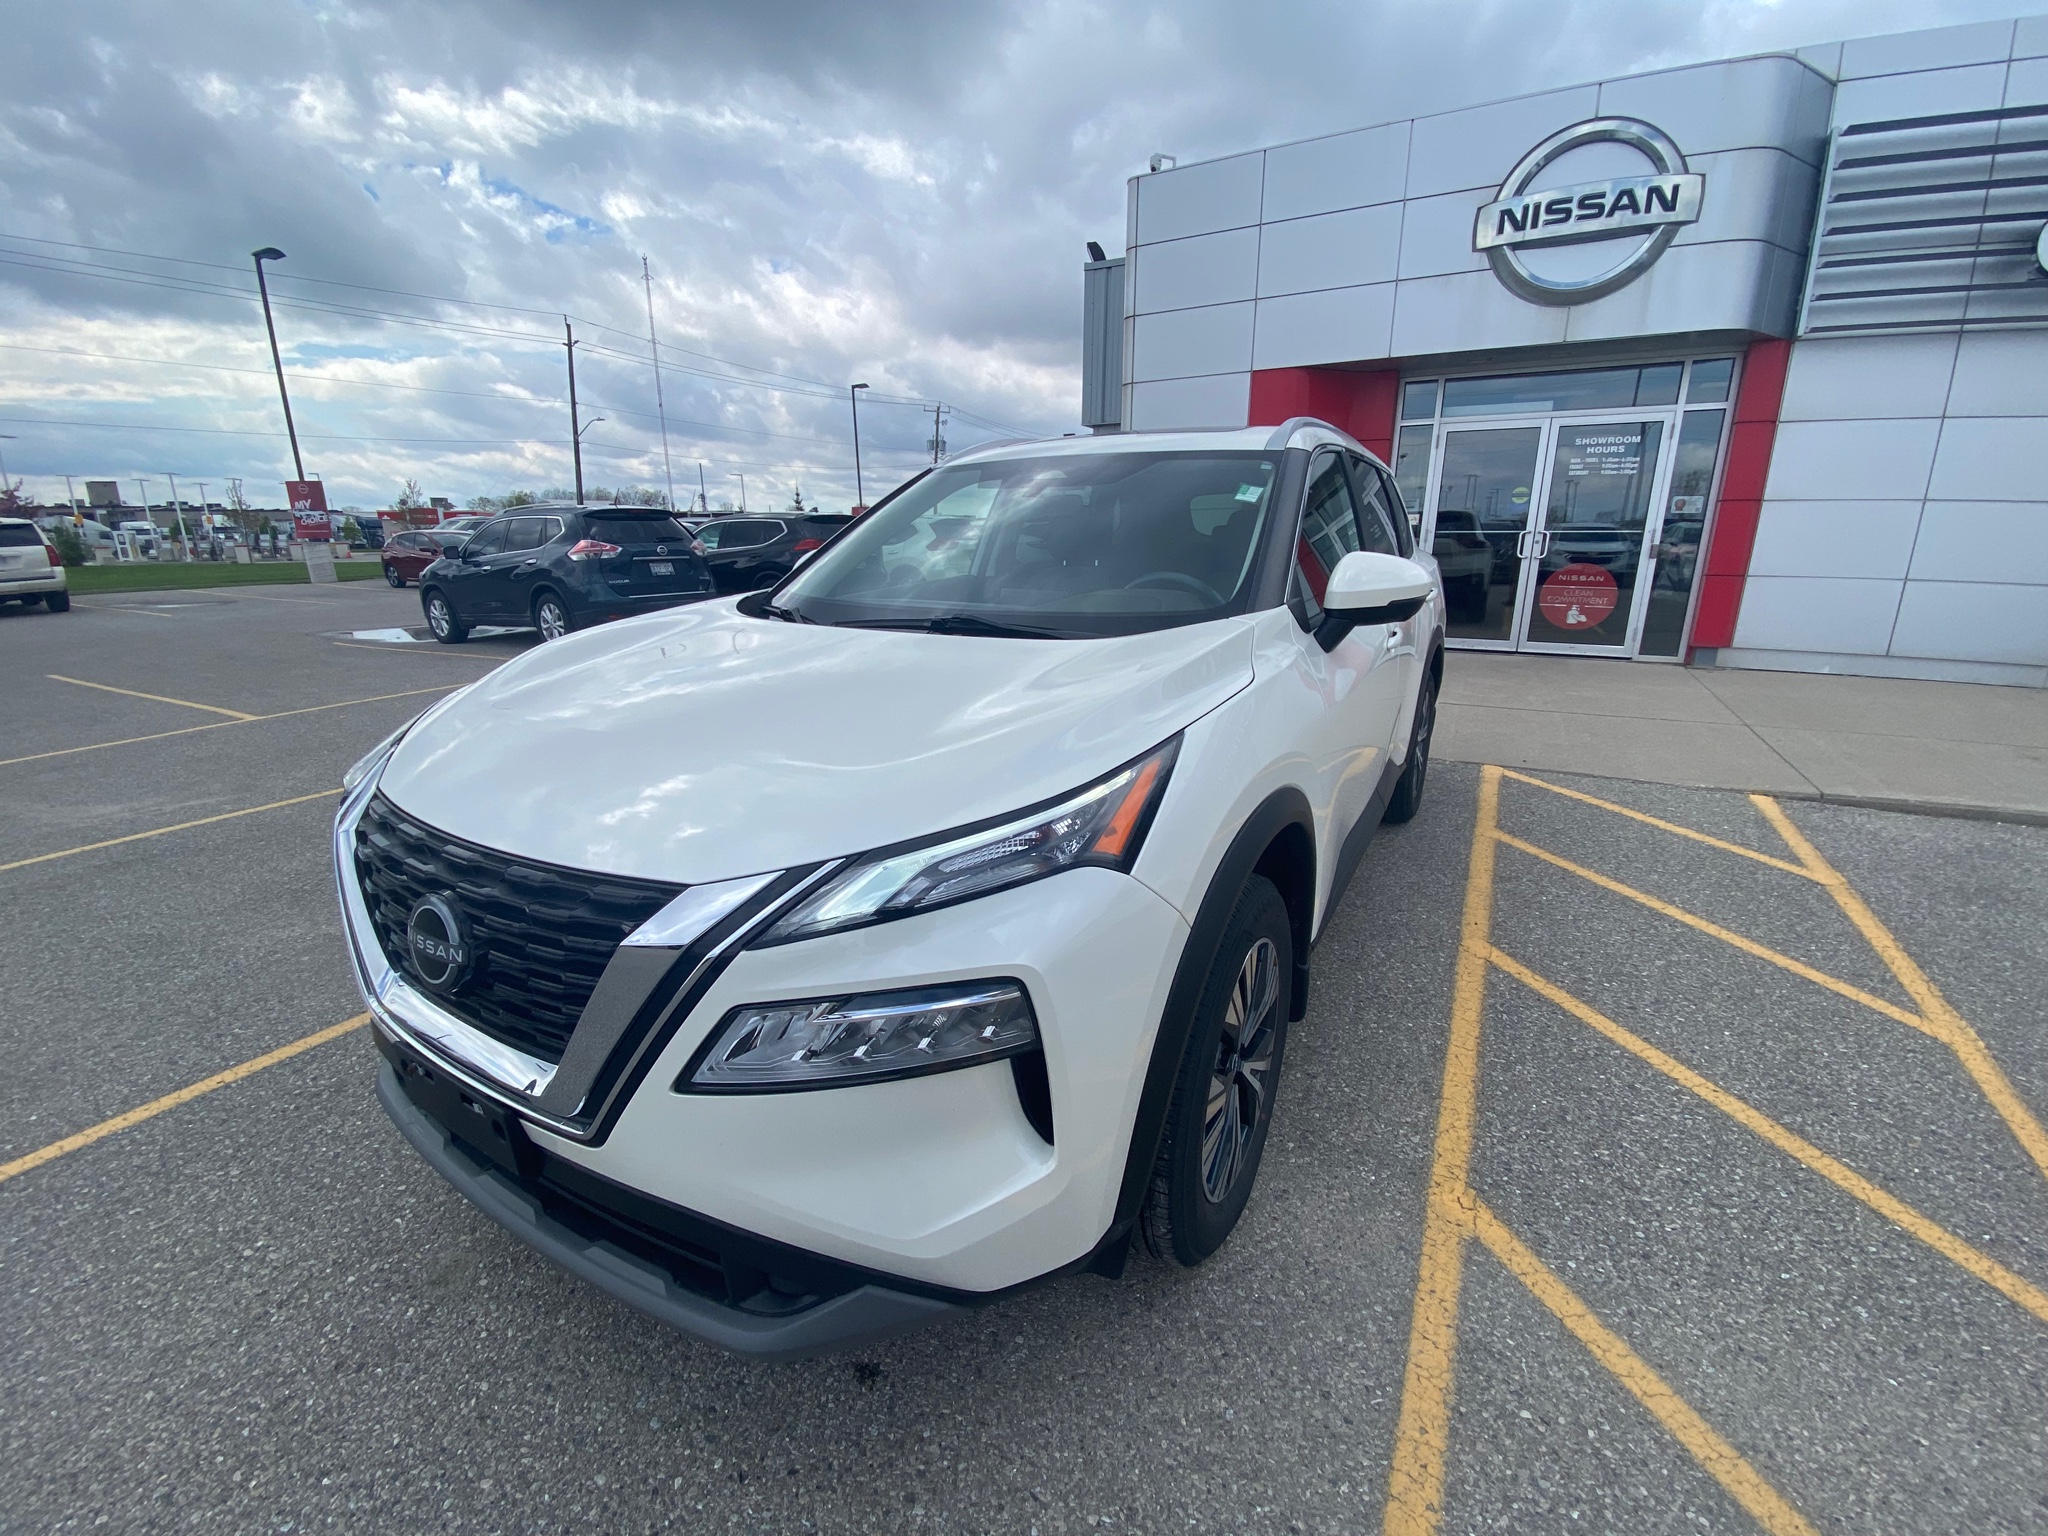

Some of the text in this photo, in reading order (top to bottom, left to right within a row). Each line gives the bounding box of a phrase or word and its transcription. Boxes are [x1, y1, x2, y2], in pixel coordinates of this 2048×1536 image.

[1496, 184, 1681, 236] NISSAN
[1575, 436, 1641, 446] SHOWROOM
[1586, 445, 1625, 454] HOURS
[294, 499, 312, 509] MY
[1558, 574, 1604, 582] NISSAN
[1564, 589, 1594, 597] CLEAN
[1547, 596, 1609, 605] COMMITMENT
